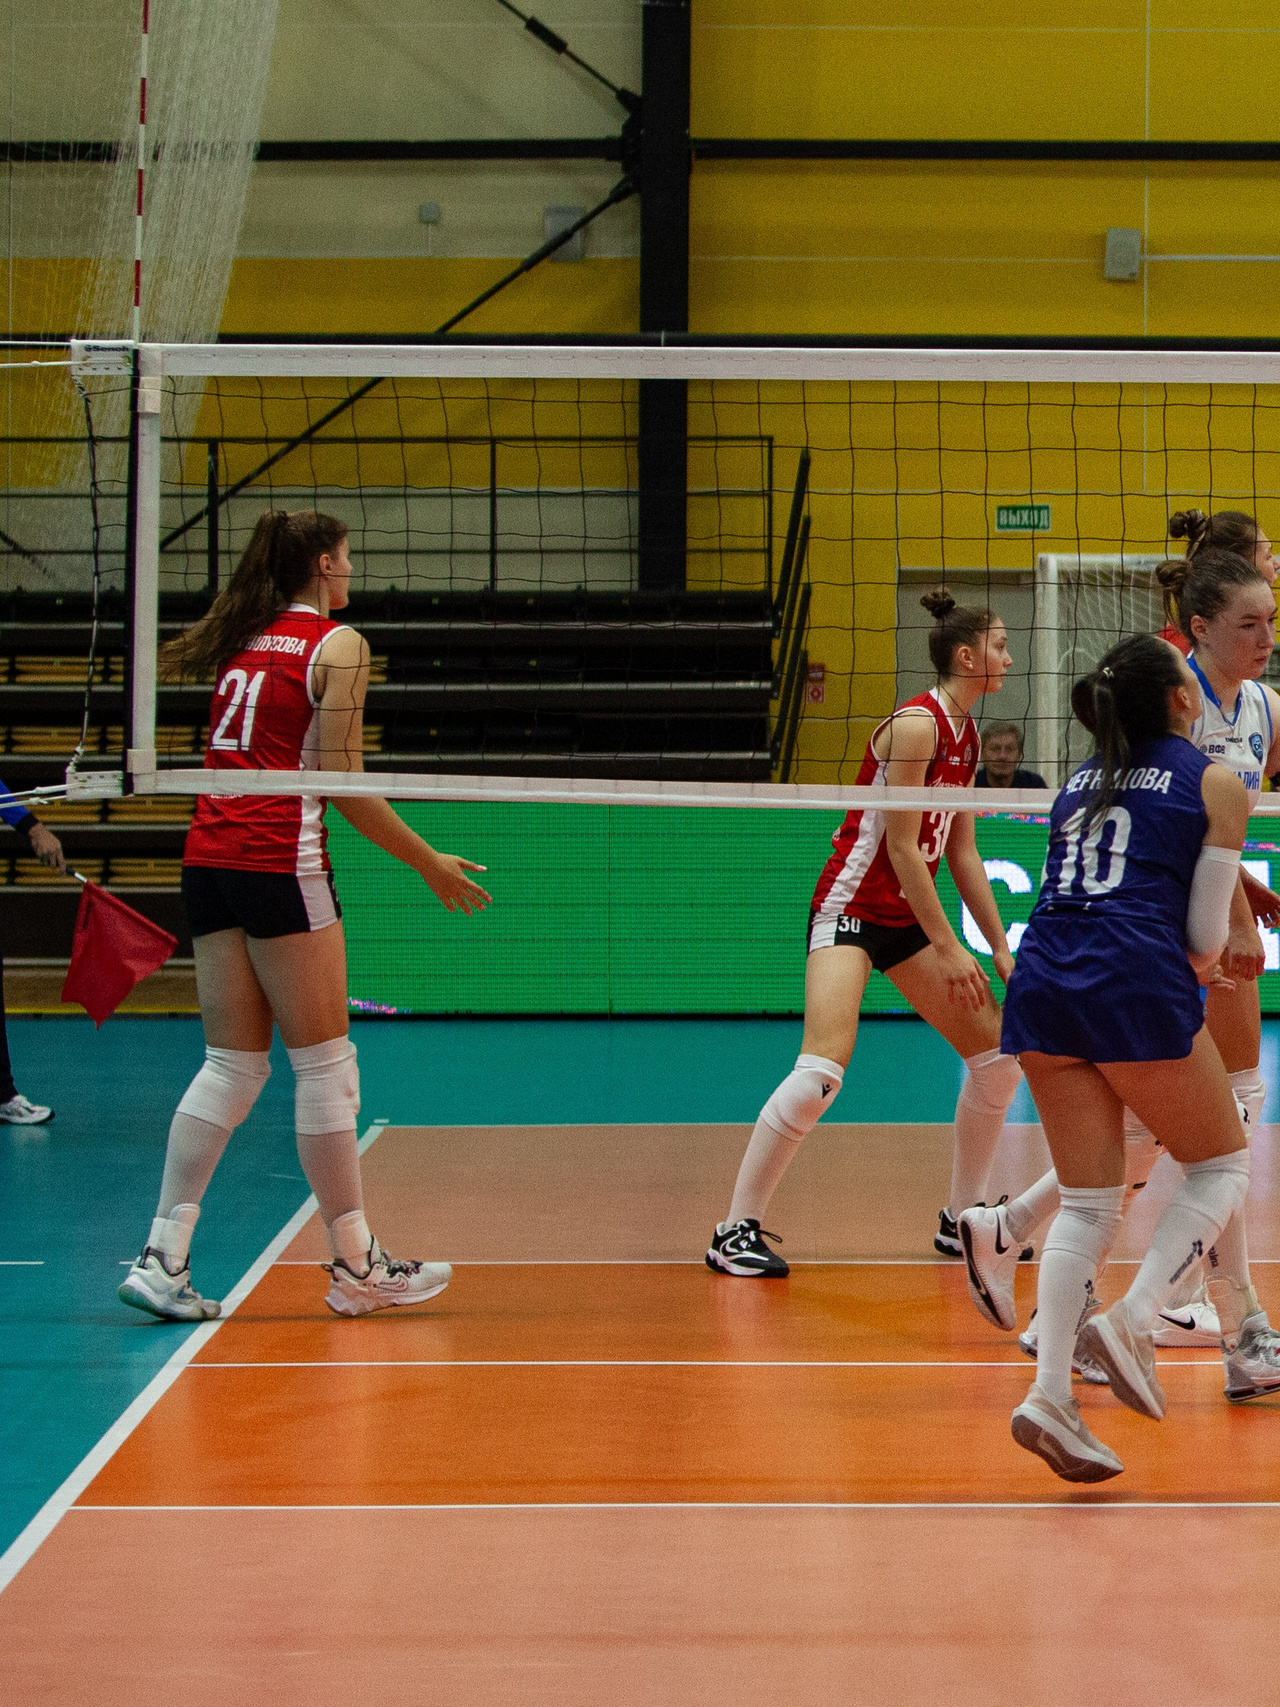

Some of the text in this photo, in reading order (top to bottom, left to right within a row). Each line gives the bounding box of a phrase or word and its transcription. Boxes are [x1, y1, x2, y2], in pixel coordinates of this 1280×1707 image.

[1000, 509, 1048, 527] ВЫХОД
[210, 668, 266, 751] 21
[1057, 806, 1132, 896] 10
[838, 915, 861, 933] 30
